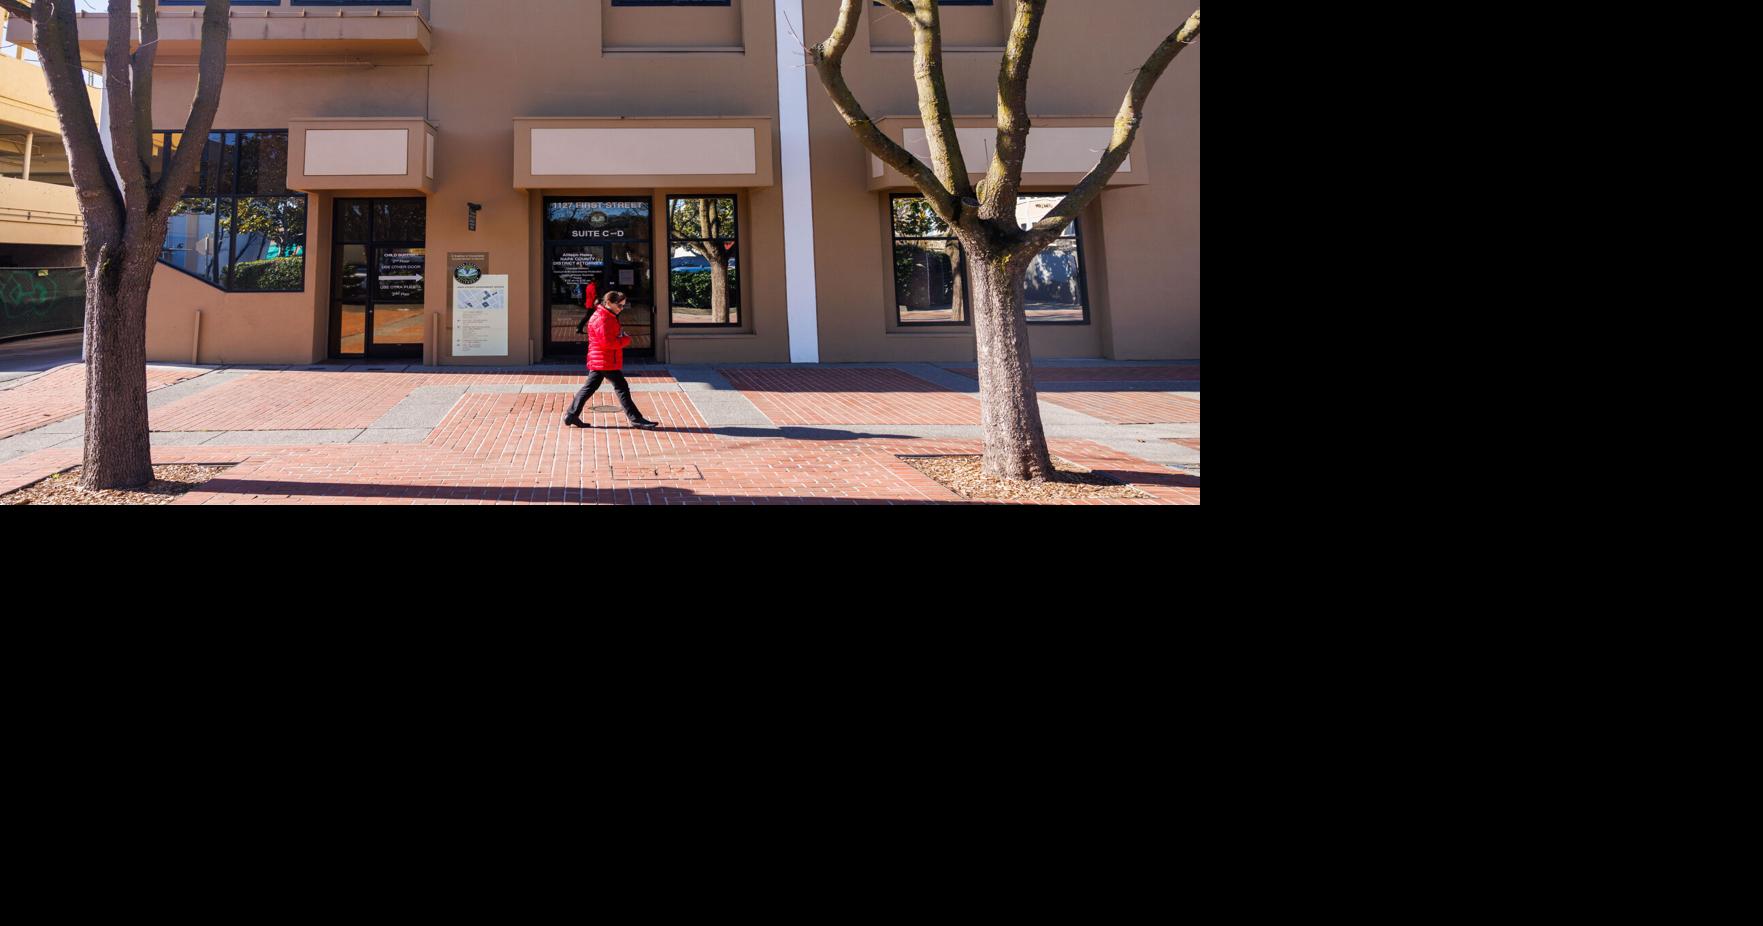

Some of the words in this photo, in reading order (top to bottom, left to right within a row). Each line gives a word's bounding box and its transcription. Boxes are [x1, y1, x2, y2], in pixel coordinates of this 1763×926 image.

[553, 201, 573, 209] 1127
[575, 201, 602, 209] FIRST
[605, 201, 642, 209] STREET
